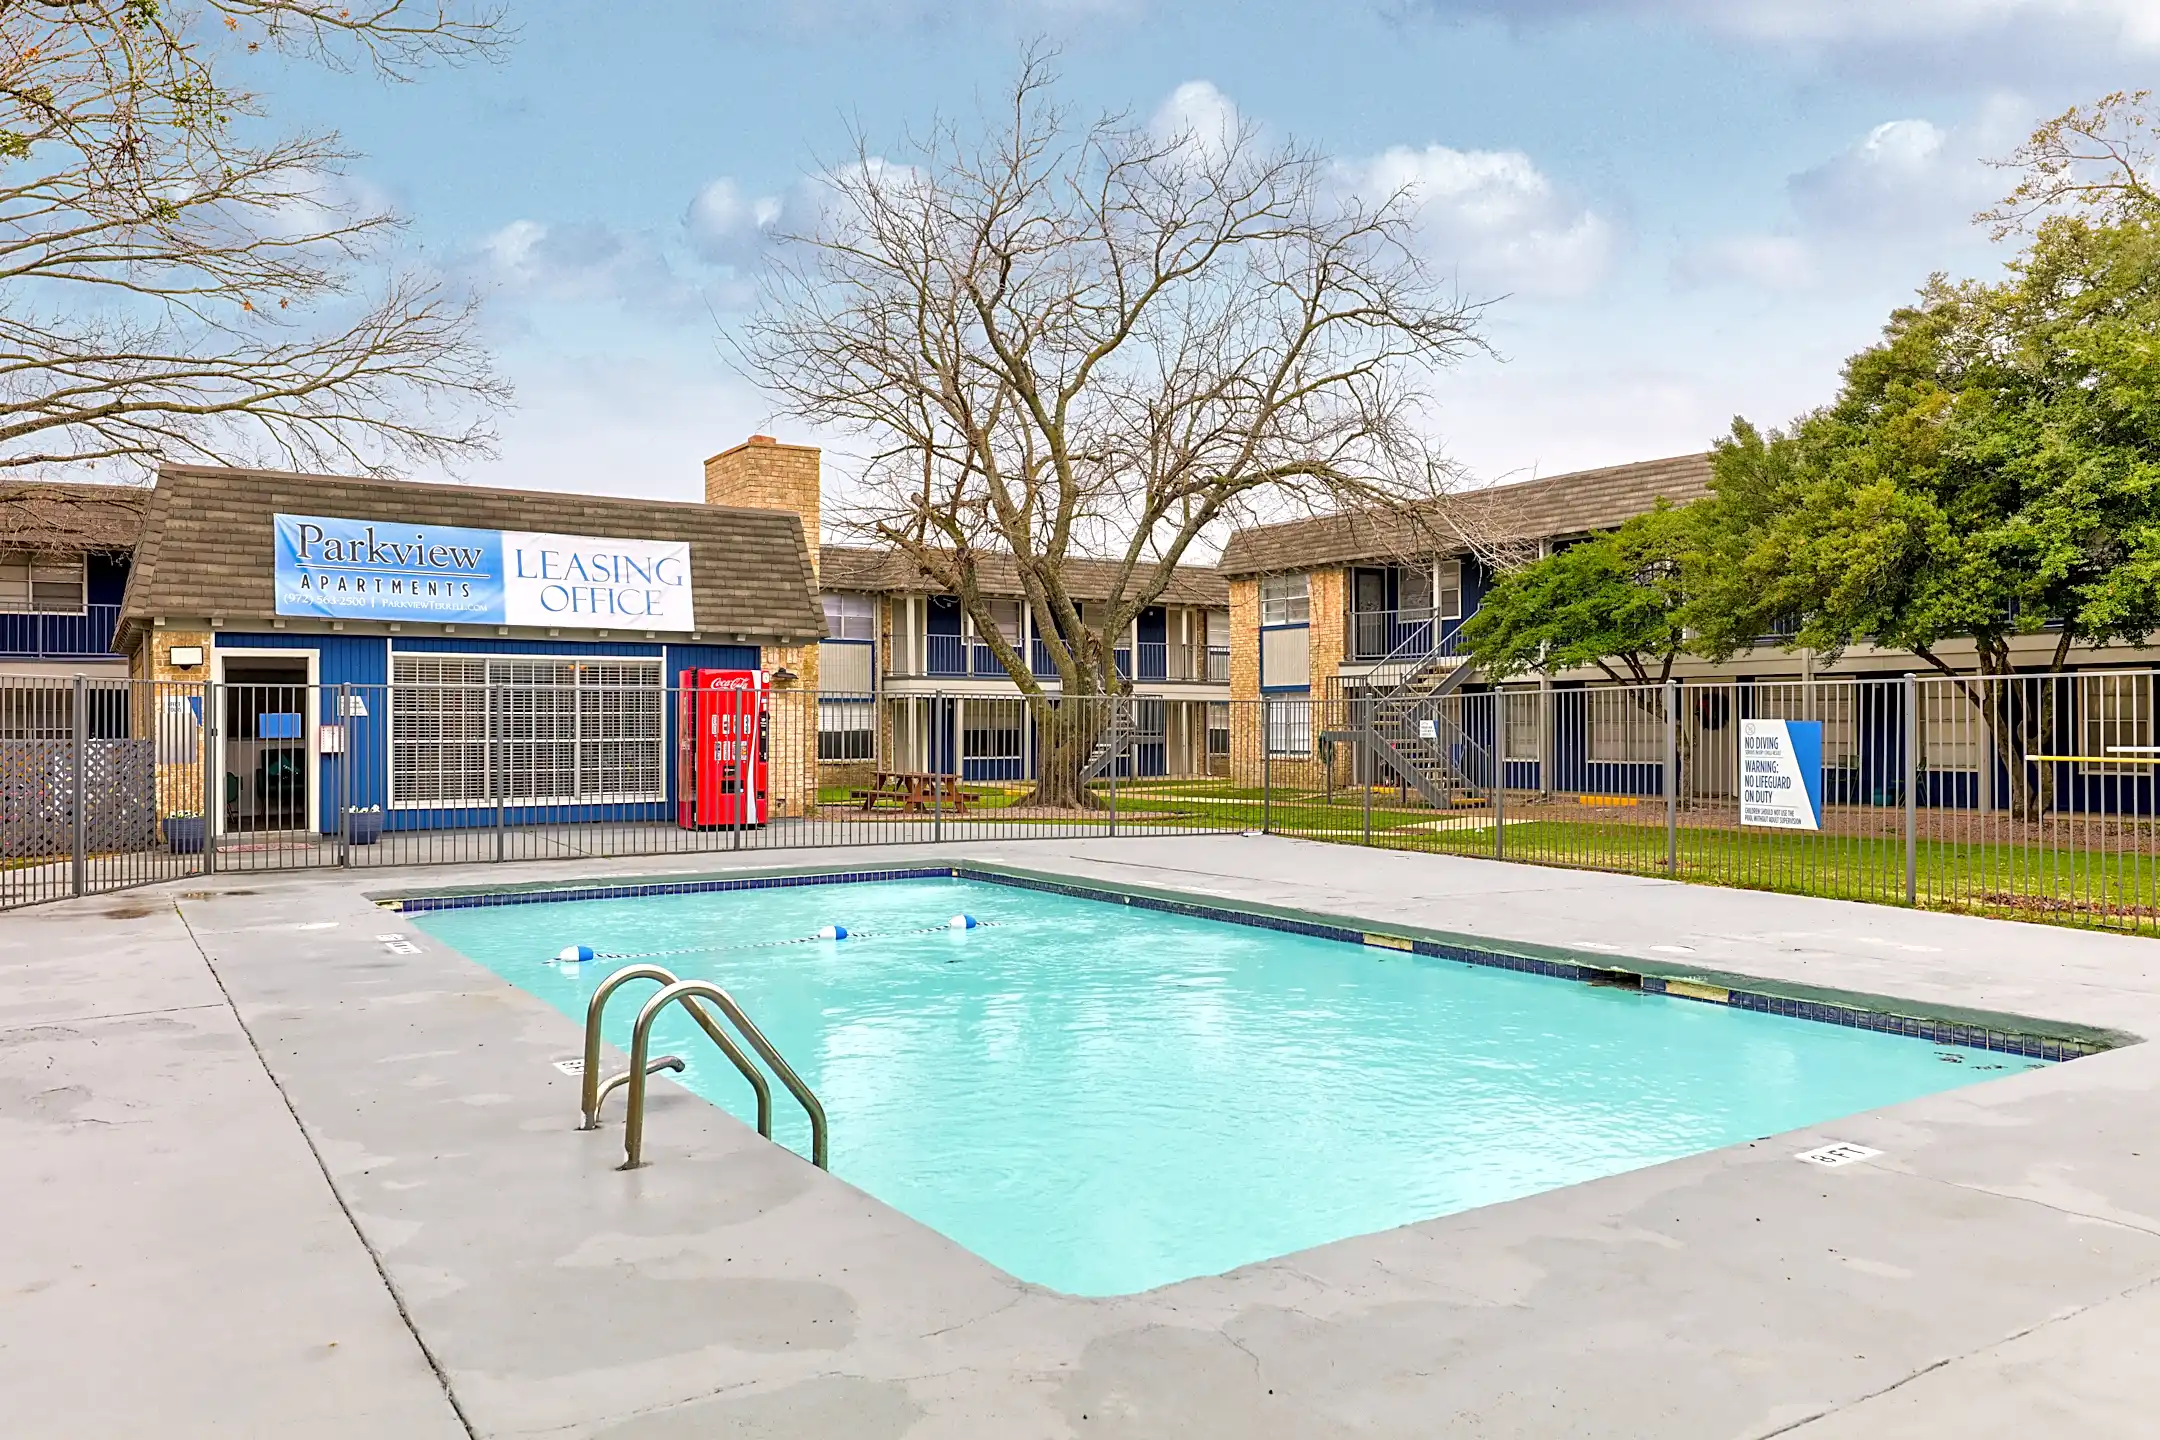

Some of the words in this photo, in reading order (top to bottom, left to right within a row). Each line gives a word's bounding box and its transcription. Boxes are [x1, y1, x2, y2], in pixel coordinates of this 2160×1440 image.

[296, 523, 483, 568] Parkview
[516, 549, 682, 586] LEASING
[301, 574, 470, 597] APARTMENTS
[283, 593, 313, 606] (972)
[316, 594, 366, 607] 563-2500
[540, 584, 664, 616] OFFICE
[1745, 736, 1755, 749] NO
[1756, 736, 1779, 750] DIVING
[1745, 759, 1779, 774] WARNING:
[1745, 774, 1755, 788] NO
[1755, 775, 1791, 789] LIFEGUARD
[1745, 790, 1755, 803] ON
[1755, 790, 1773, 803] DUTY
